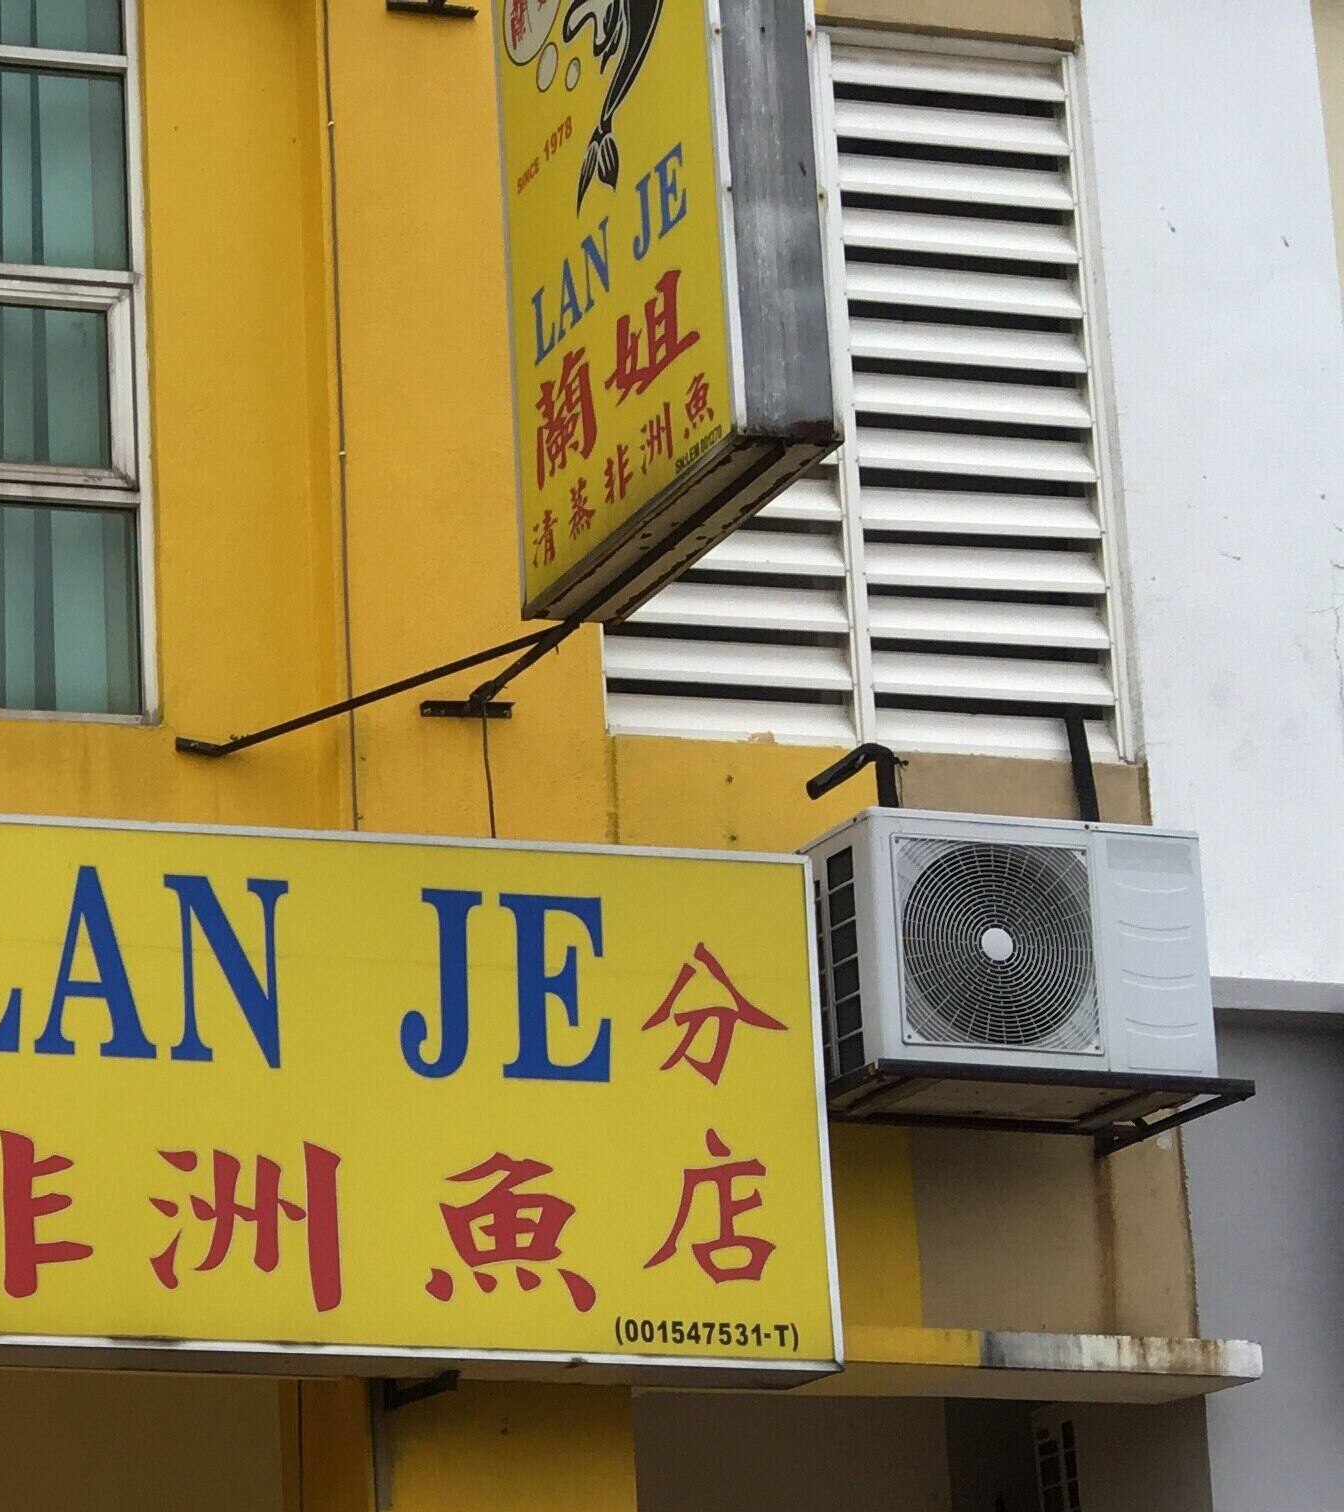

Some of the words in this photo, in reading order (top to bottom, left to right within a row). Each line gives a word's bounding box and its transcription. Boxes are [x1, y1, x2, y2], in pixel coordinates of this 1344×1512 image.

[516, 156, 540, 194] SINCE
[543, 115, 572, 160] 1978
[530, 217, 611, 367] LAN
[632, 141, 688, 262] JE
[531, 370, 715, 570] 清蒸非洲魚
[535, 268, 701, 492] 蘭姐
[399, 886, 612, 1084] JE
[615, 1316, 800, 1352] (001547531-T)
